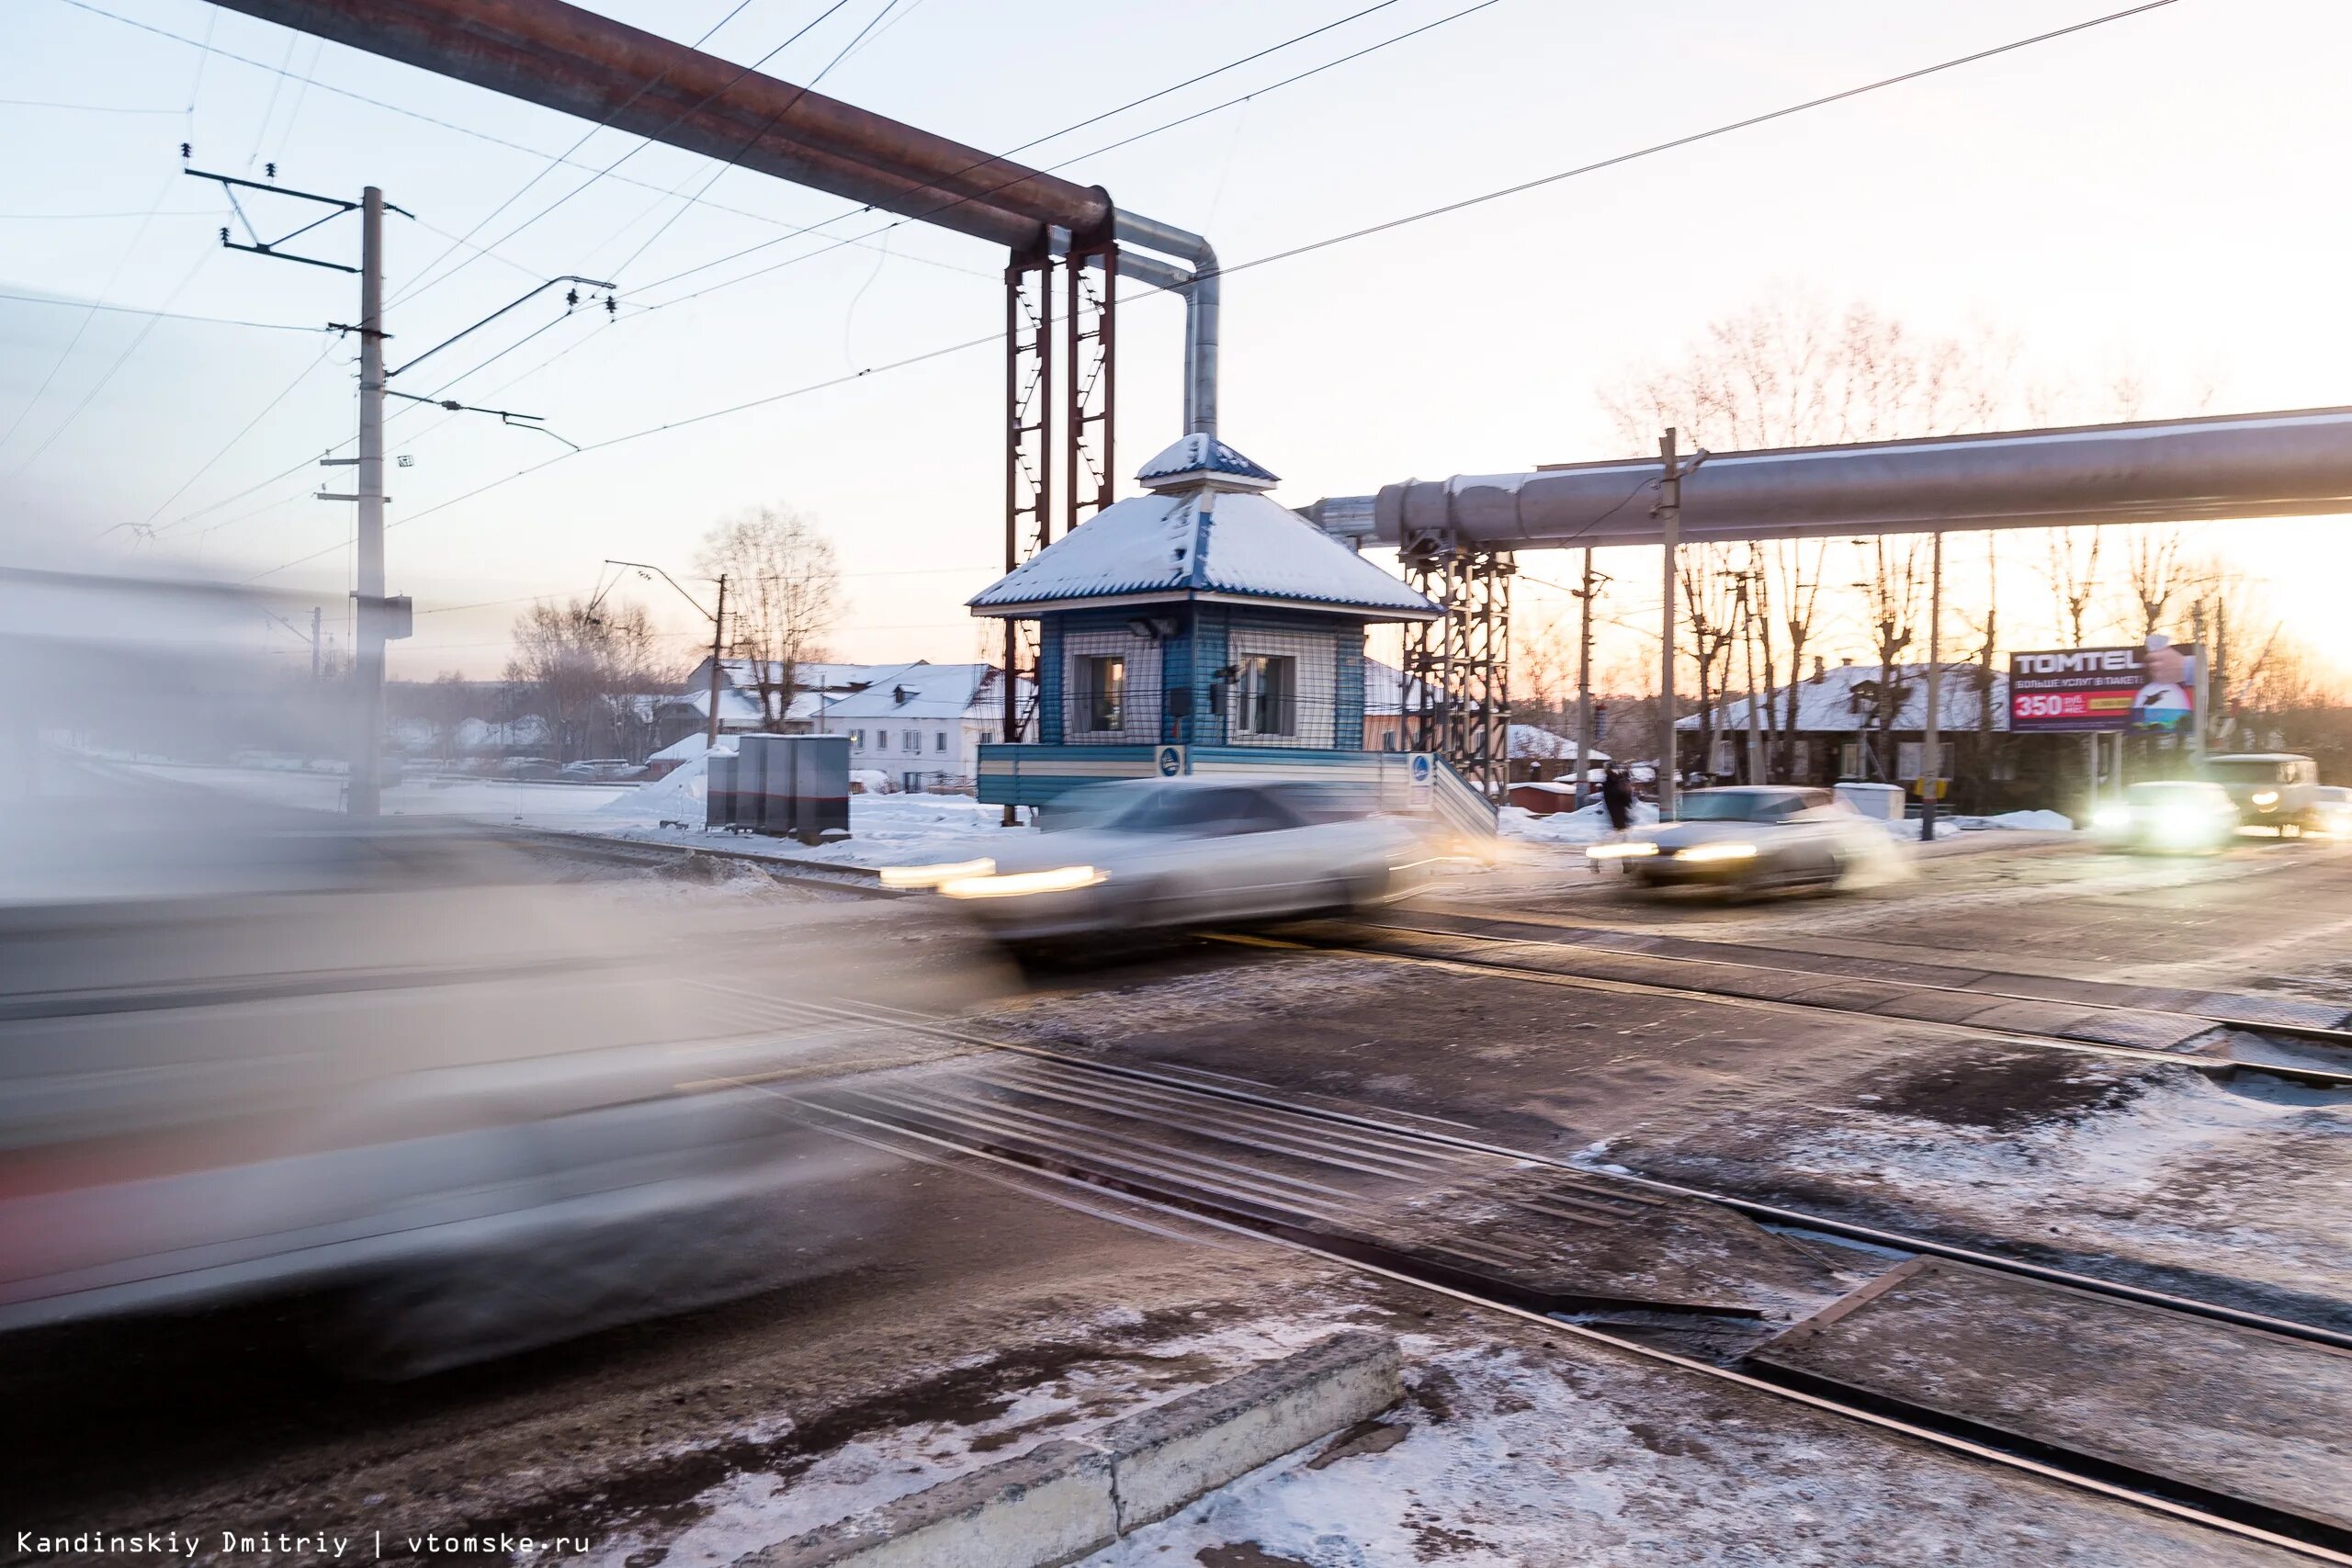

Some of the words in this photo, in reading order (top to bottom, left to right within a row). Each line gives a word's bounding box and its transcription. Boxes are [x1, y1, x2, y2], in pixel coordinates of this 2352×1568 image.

[2015, 650, 2144, 673] TOMTEL
[2016, 680, 2061, 689] БОЛЬШЕ
[2063, 678, 2092, 687] УСЛУГ
[2015, 695, 2062, 716] 350
